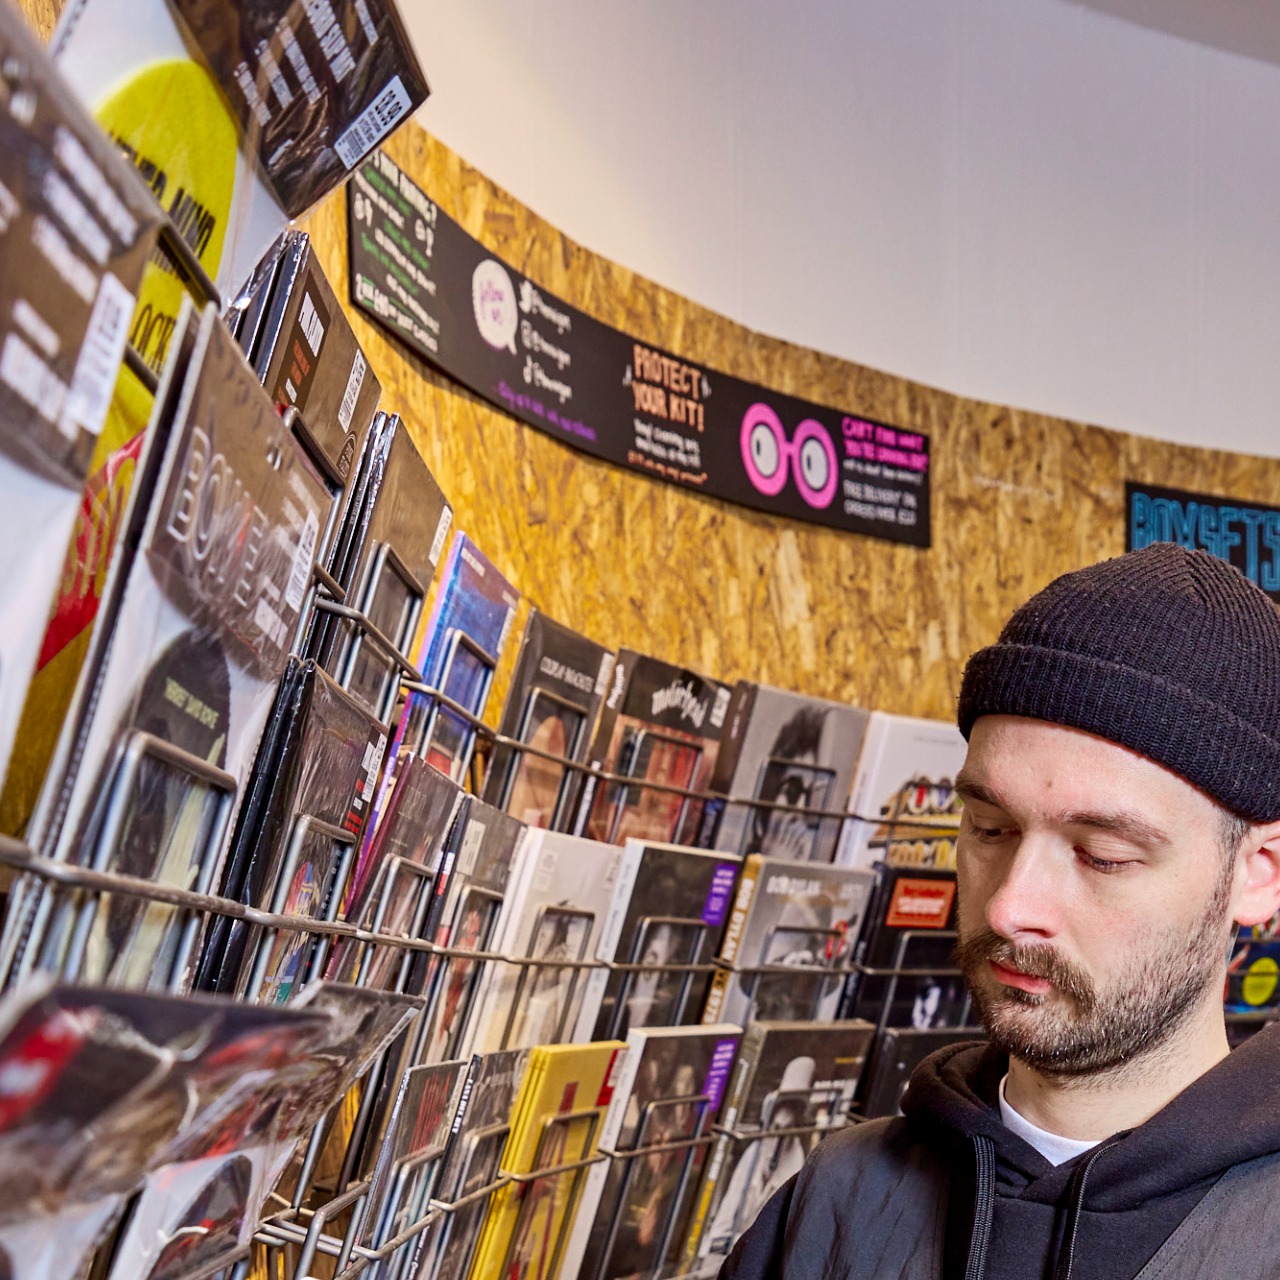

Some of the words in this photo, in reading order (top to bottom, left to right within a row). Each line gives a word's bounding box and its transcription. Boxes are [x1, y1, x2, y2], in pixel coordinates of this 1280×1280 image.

[634, 344, 702, 400] PROTECT
[632, 381, 668, 419] YOUR
[670, 393, 704, 432] KIT!
[463, 1078, 474, 1100] LANA
[451, 1115, 462, 1135] REY
